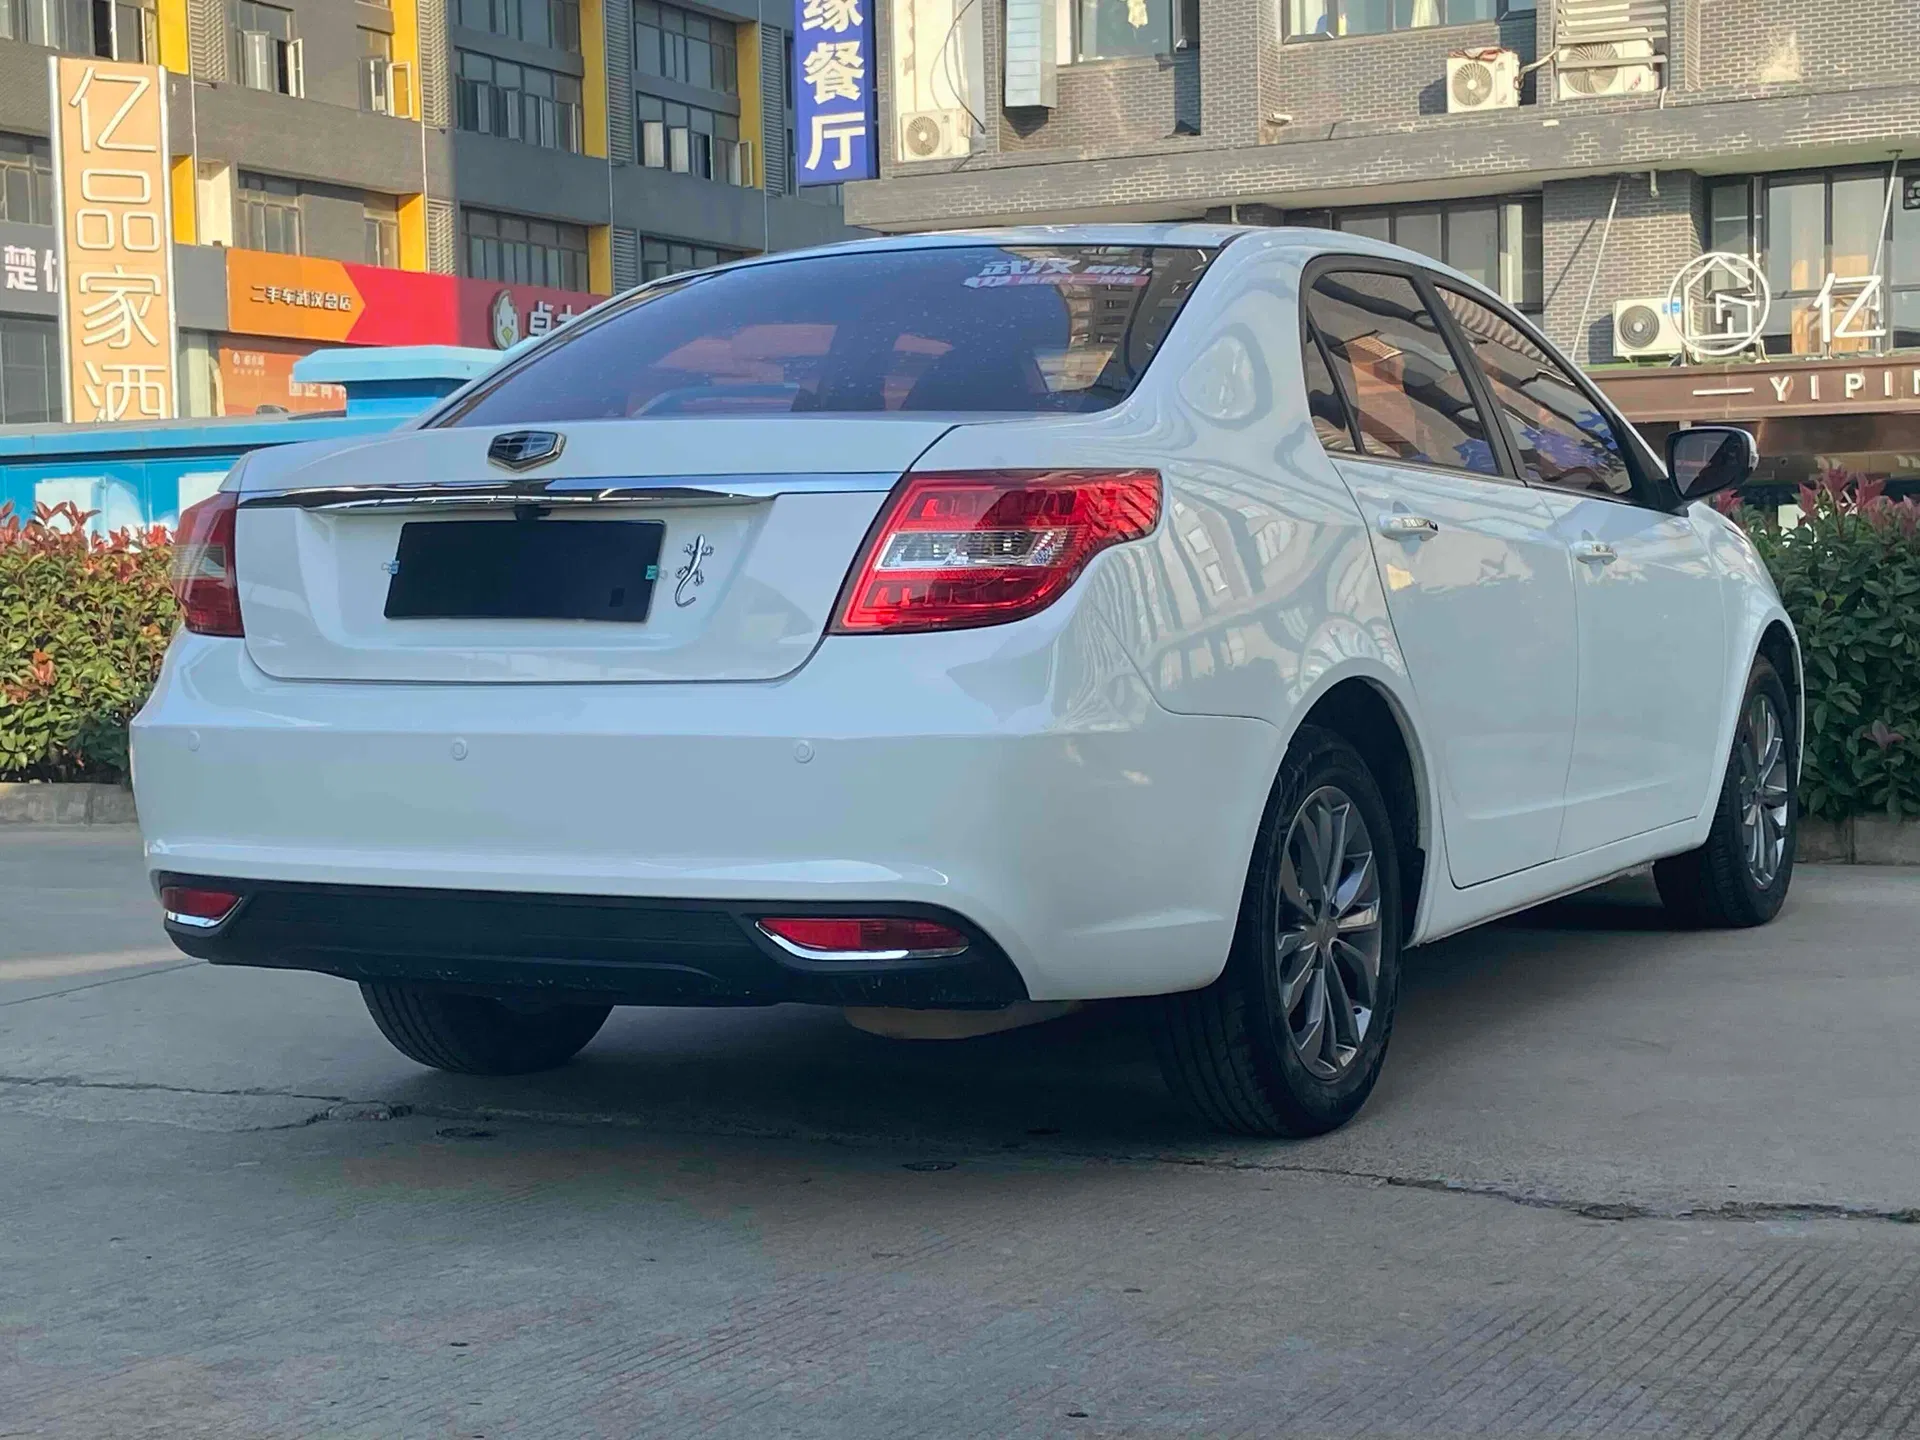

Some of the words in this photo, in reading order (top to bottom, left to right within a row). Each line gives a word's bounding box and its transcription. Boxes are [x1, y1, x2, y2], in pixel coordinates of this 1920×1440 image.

[250, 285, 352, 312] 二手车武汉总店
[1813, 272, 1887, 343] 亿
